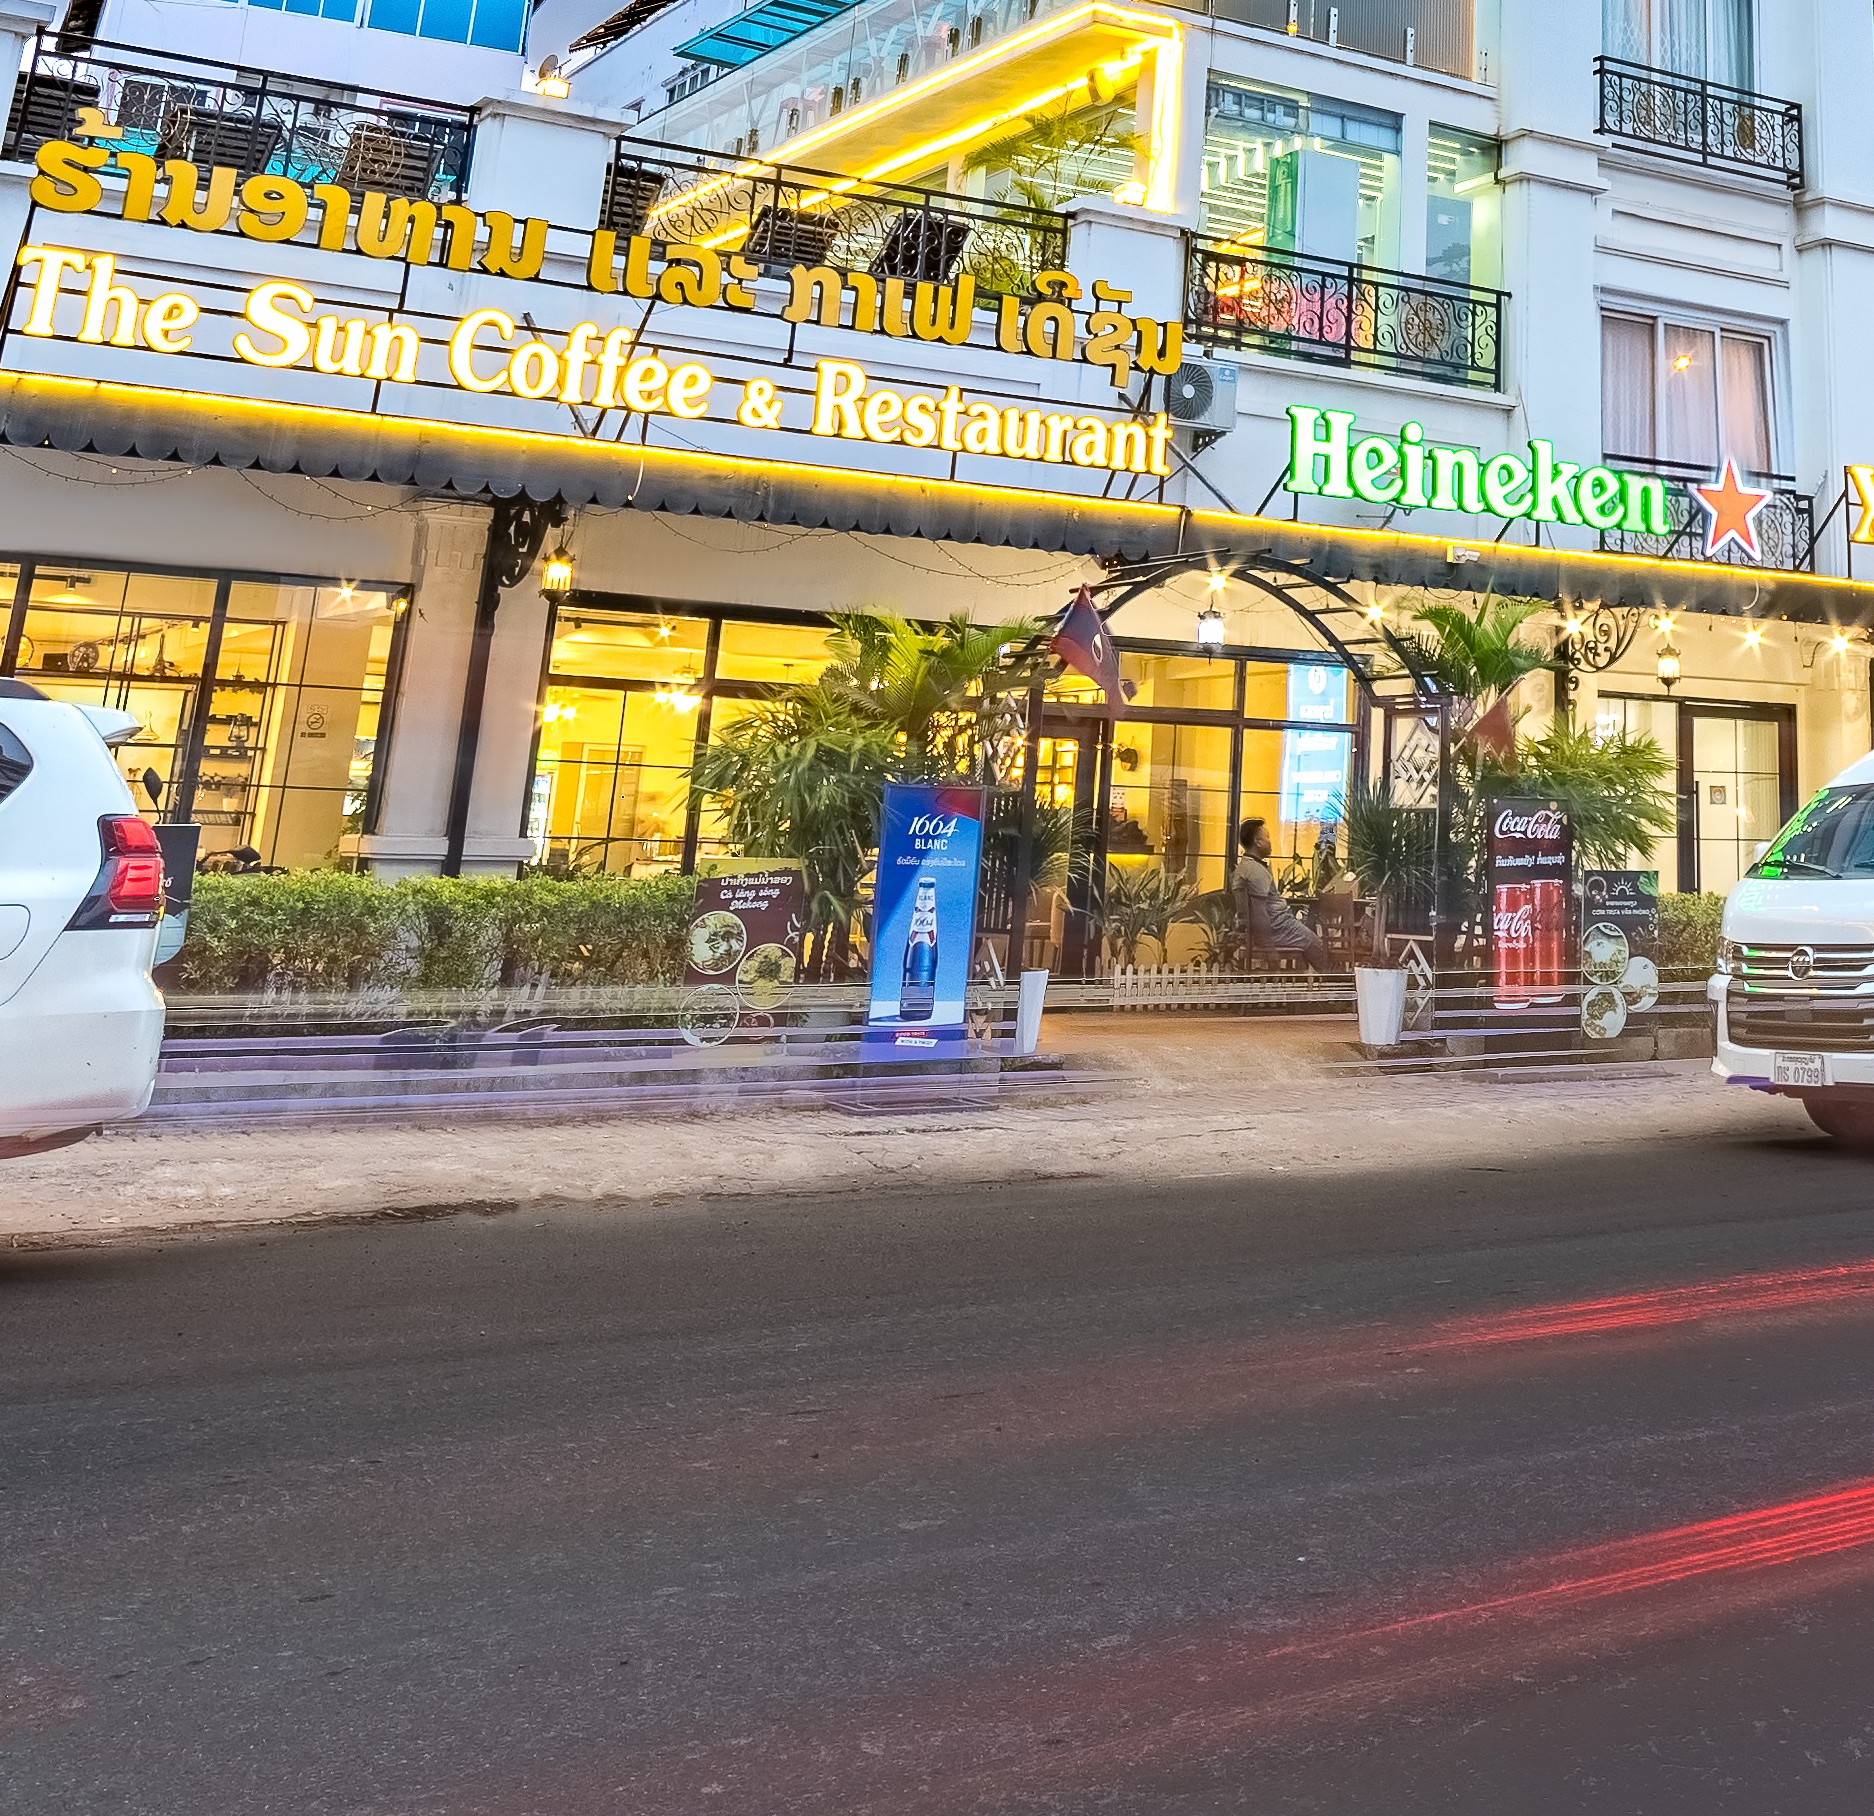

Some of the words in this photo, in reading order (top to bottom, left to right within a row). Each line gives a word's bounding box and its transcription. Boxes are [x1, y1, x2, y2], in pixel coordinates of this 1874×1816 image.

[29, 107, 550, 280] ຮ້ານອາຫານ
[587, 228, 760, 309] ແລະ
[17, 243, 199, 357] The
[231, 280, 423, 384] Sun
[448, 307, 713, 419] Coffee
[737, 377, 782, 429] &
[811, 359, 1173, 477] Restaurant
[1285, 404, 1672, 536] Heineken
[908, 813, 959, 837] 1664
[1494, 809, 1562, 839] Coca-Cola
[915, 839, 948, 850] BLANC
[729, 899, 769, 910] Mekong
[1793, 1066, 1820, 1084] 0799
